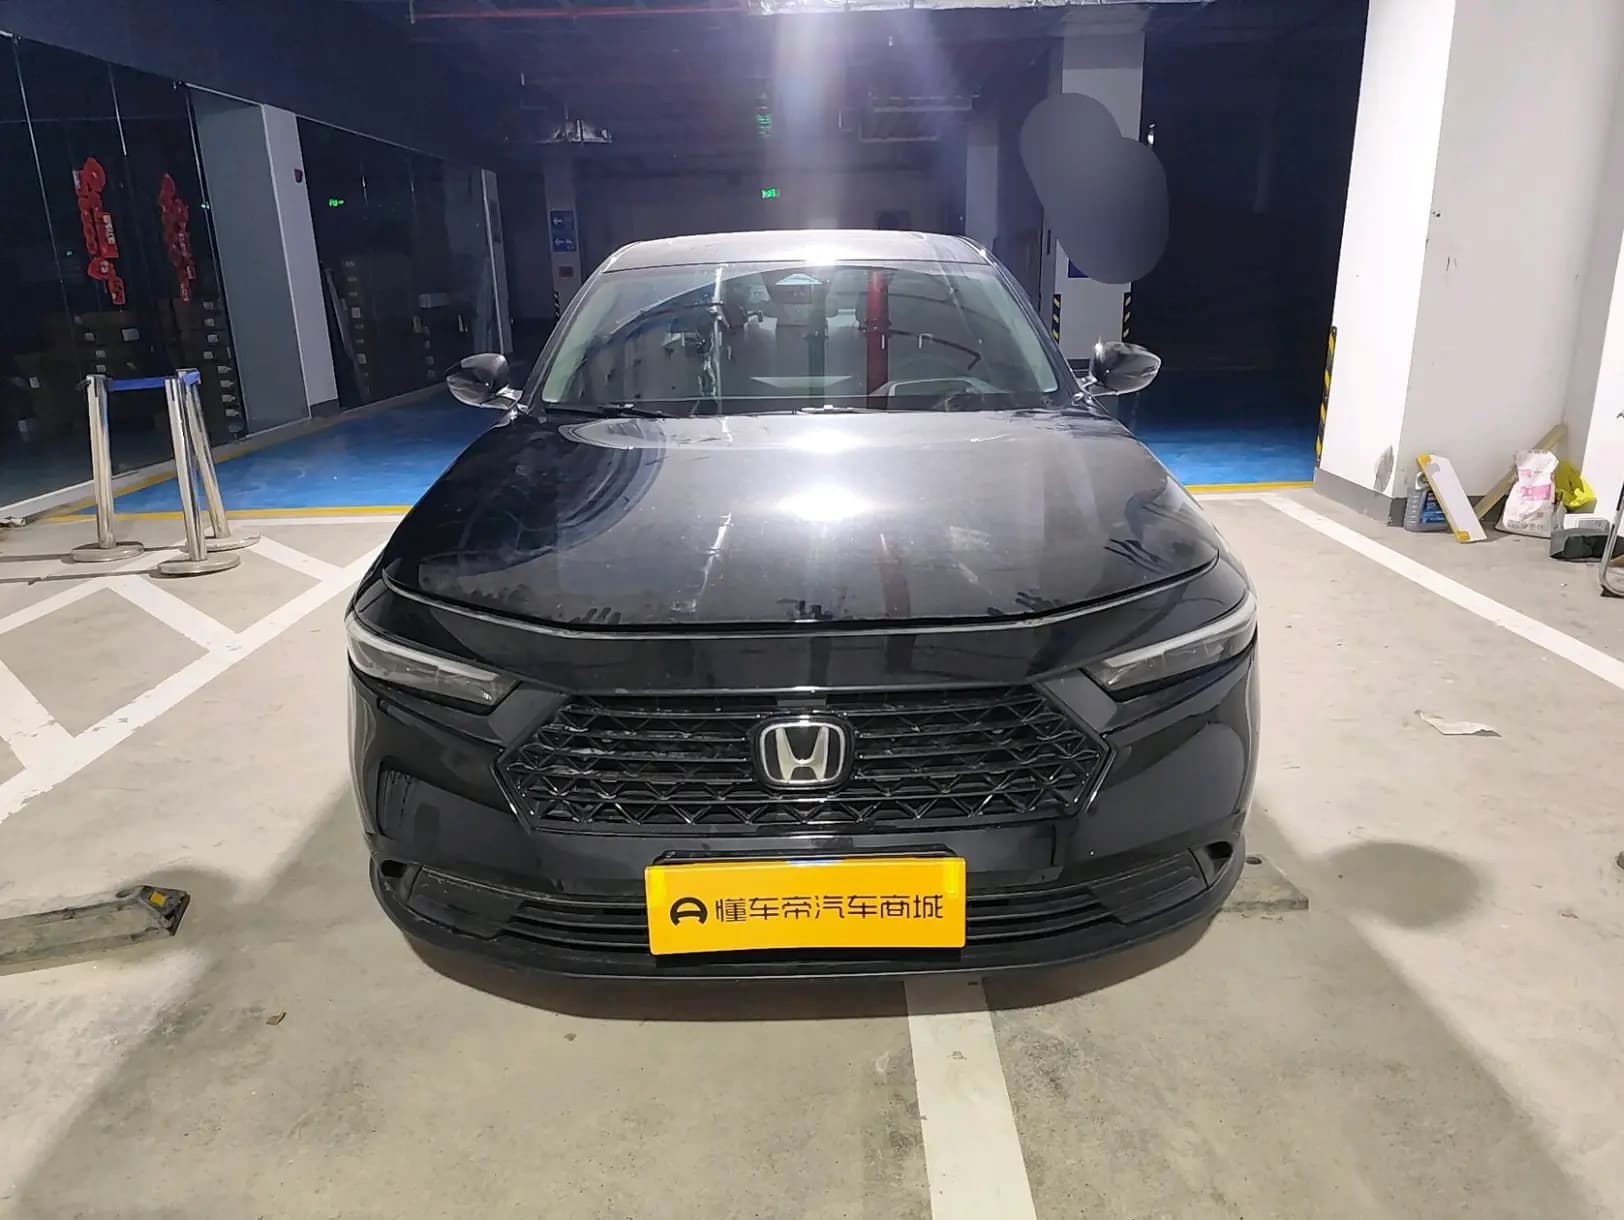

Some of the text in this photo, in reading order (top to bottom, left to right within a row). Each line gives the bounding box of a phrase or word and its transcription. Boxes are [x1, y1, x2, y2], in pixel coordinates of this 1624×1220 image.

[715, 894, 943, 922] 懂车帝汽车商城
